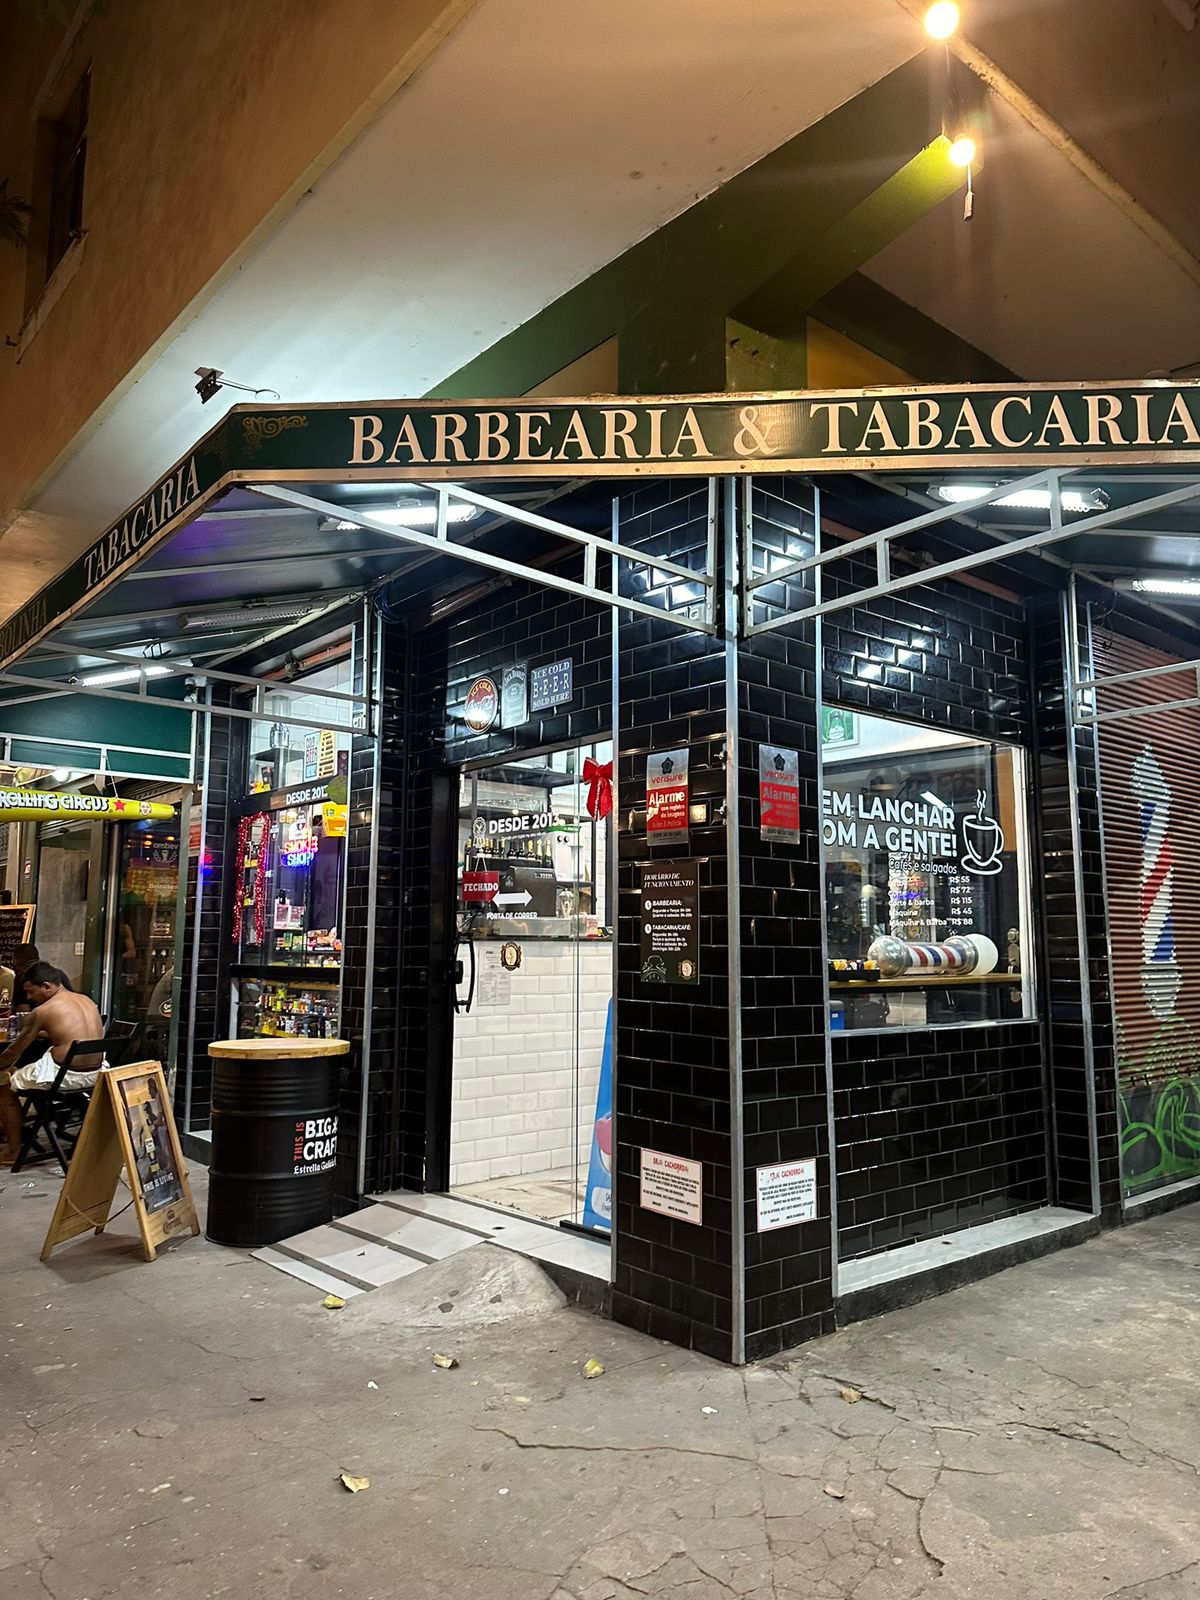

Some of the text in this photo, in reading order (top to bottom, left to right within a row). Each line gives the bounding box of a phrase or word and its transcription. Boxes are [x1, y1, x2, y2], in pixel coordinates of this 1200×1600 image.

[348, 392, 1200, 465] BARBEARIA & TABACARIA
[83, 455, 201, 590] TABACARIA
[533, 661, 570, 680] ICE COLD
[470, 682, 492, 697] ICE COLD
[533, 691, 570, 709] SOLD HERE
[651, 773, 683, 784] verisure
[286, 788, 311, 805] DESDE
[649, 791, 685, 806] Alarme
[763, 786, 797, 802] Alarme
[60, 795, 110, 812] CIRCUS
[857, 793, 956, 830] LANCHAR
[489, 810, 561, 834] DESDE 2013
[863, 824, 881, 850] A
[885, 826, 958, 858] GENTE!
[888, 858, 957, 875] Cafés e salgados
[644, 872, 671, 880] HORÁRIO
[644, 880, 694, 888] FUNCIONAMENTO
[464, 882, 499, 891] FECHADO
[961, 886, 971, 894] 72
[950, 897, 961, 905] R$
[486, 912, 506, 920] PORTA
[513, 911, 538, 919] CORRER
[962, 907, 973, 915] 45
[951, 918, 962, 926] R$
[305, 1117, 332, 1139] BIG
[293, 1121, 305, 1161] THIS IS
[293, 1163, 320, 1175] Estrella
